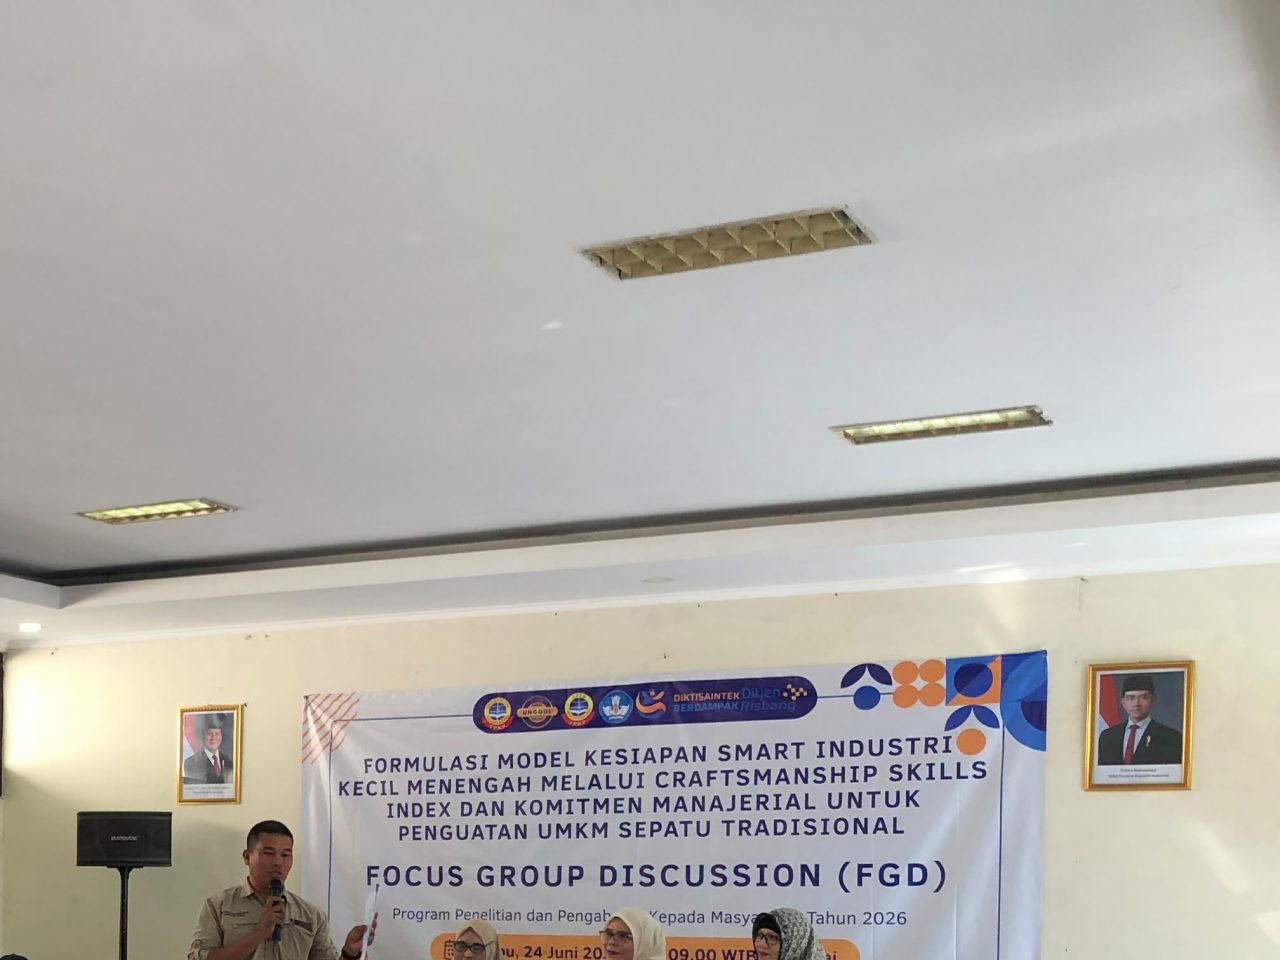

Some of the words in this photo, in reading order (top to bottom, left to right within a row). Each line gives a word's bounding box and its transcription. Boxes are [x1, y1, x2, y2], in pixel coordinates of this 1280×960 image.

[673, 692, 740, 702] DIKTISAINTEK
[673, 702, 739, 713] BERDAMPAK
[364, 754, 489, 774] FORMULASI
[497, 751, 576, 770] MODEL
[585, 746, 708, 767] KESIAPAN
[717, 741, 806, 763] SMART
[815, 735, 953, 759] INDUSTRI
[338, 780, 399, 797] KECIL
[407, 776, 531, 796] MENENGAH
[541, 772, 645, 792] MELALUI
[655, 765, 878, 789] CRAFTSMANSHIP
[888, 760, 988, 782] SKILLS
[386, 802, 452, 819] INDEX
[460, 800, 506, 817] DAN
[515, 797, 643, 816] KOMITMEN
[653, 793, 816, 814] MANAJERIAL
[827, 789, 921, 810] UNTUK
[399, 824, 528, 841] PENGUATAN
[538, 822, 609, 840] UMKM
[618, 820, 711, 838] SEPATU
[722, 817, 905, 837] TRADISIONAL
[366, 865, 464, 887] FOCUS
[477, 865, 585, 887] GROUP
[599, 863, 820, 887] DISCUSSION
[837, 860, 946, 893] (FGD)
[392, 908, 451, 923] Program
[456, 909, 522, 922] Penelitian
[526, 909, 553, 922] dan
[557, 909, 611, 926] Pengab
[807, 911, 857, 925] Tahun
[862, 911, 908, 925] 2026
[523, 946, 543, 958] 24
[547, 946, 578, 959] Juni
